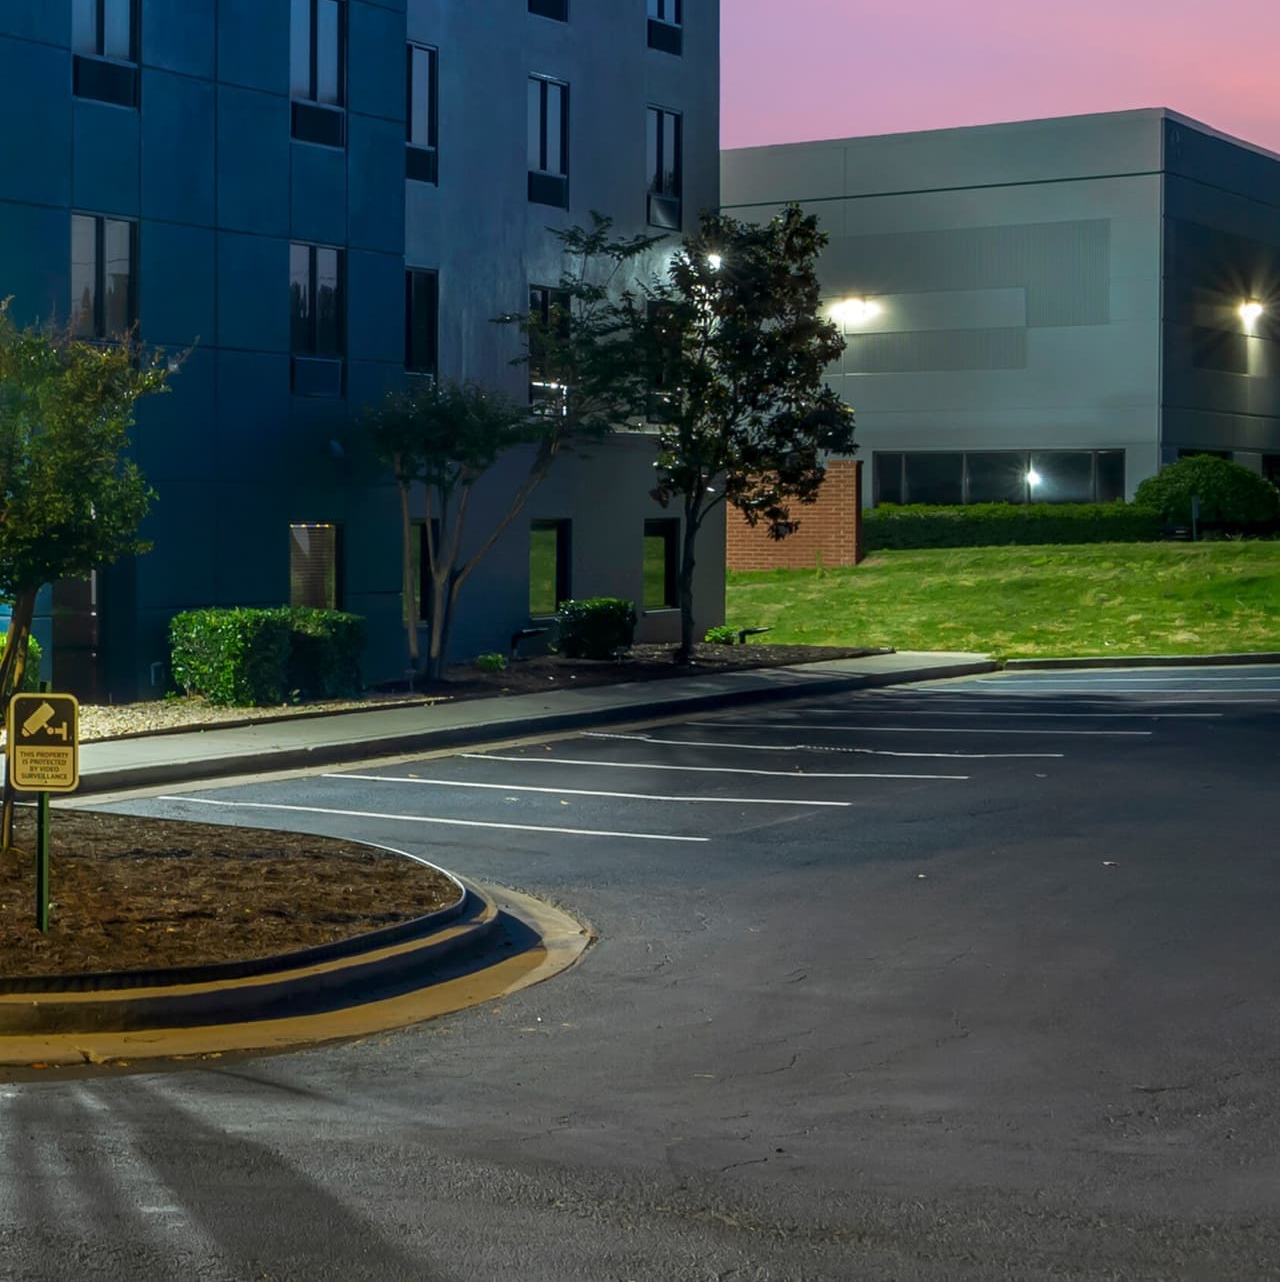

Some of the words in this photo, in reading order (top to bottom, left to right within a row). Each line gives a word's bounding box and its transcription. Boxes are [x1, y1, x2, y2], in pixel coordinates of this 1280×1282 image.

[20, 750, 35, 758] THIS
[36, 751, 69, 759] PROPERTY
[30, 758, 67, 766] PROTECTED
[40, 765, 60, 773] VIDEO
[20, 772, 68, 780] SURVEILLANCE
